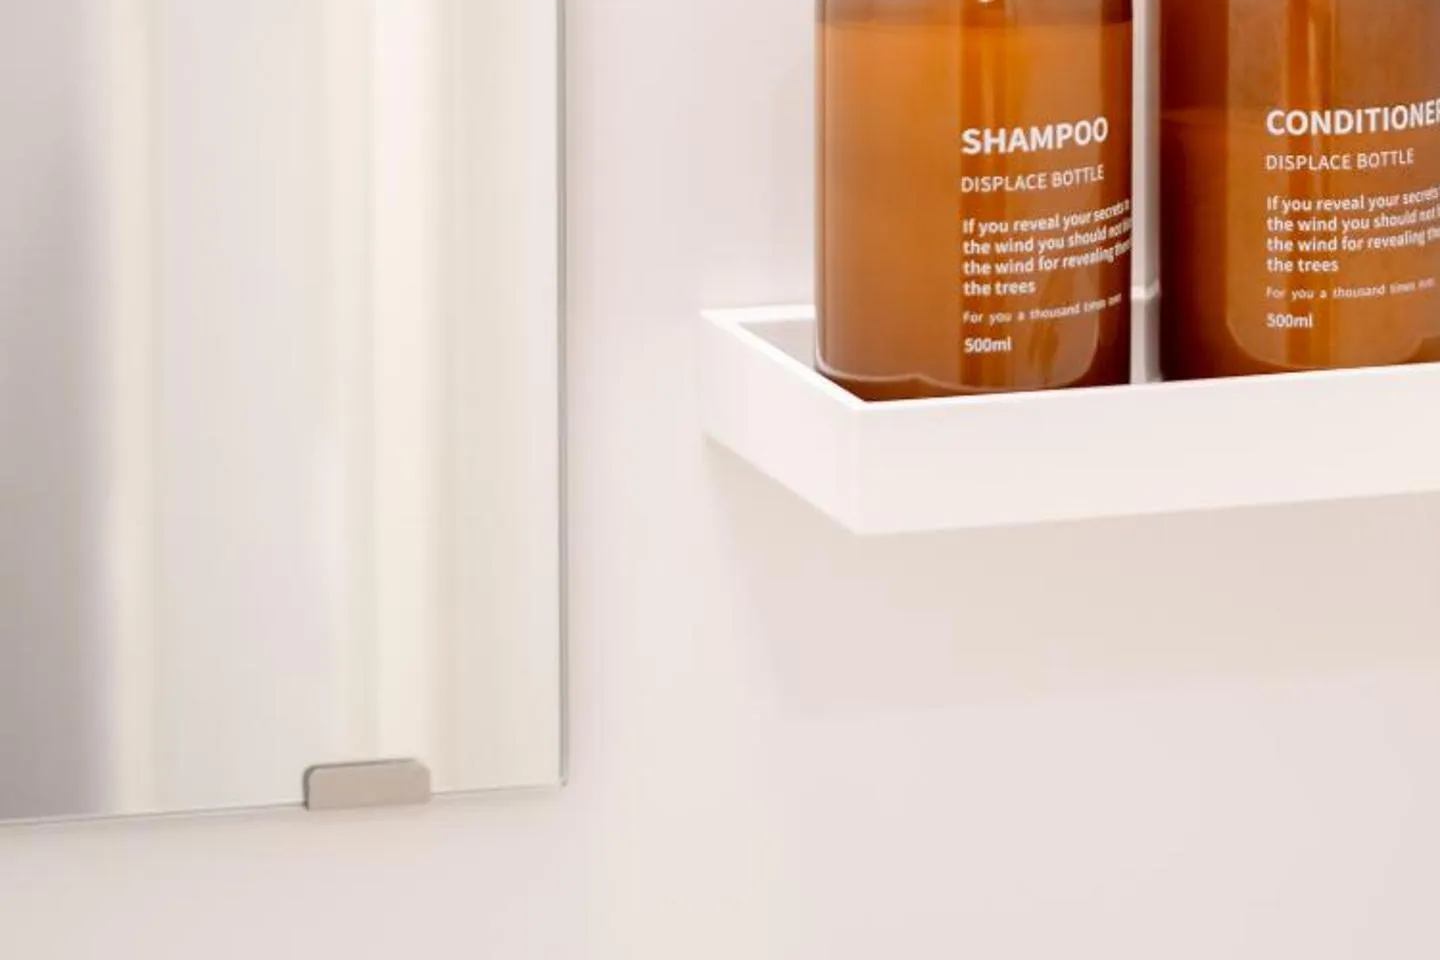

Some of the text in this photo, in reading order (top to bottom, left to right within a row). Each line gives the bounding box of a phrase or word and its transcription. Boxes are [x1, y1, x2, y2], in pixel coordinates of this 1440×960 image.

[961, 116, 1109, 155] SHAMPOO
[1265, 147, 1416, 172] DISPLACE BOTTLE
[961, 164, 1105, 193] DISPLACE BOTTLE
[1266, 195, 1280, 211] If
[1281, 199, 1312, 215] you
[1316, 194, 1365, 211] reveal
[1367, 193, 1400, 212] your
[963, 218, 975, 234] If
[978, 221, 1009, 237] you
[1013, 213, 1060, 232] reveal
[1062, 211, 1092, 232] your
[1266, 216, 1294, 232] the
[1297, 216, 1337, 232] wind
[1342, 217, 1370, 235] you
[1373, 211, 1418, 229] should
[963, 239, 991, 255] the
[995, 237, 1034, 254] wind
[1038, 236, 1065, 254] you
[1068, 224, 1107, 248] should
[1266, 236, 1294, 253] the
[1297, 236, 1337, 252] wind
[1341, 235, 1364, 250] for
[1367, 229, 1426, 249] revealing
[963, 259, 991, 276] the
[995, 257, 1034, 274] wind
[1039, 255, 1060, 271] for
[1266, 256, 1339, 273] the trees
[963, 280, 1036, 296] the trees
[1266, 285, 1286, 299] For
[1291, 288, 1315, 301] you
[1319, 289, 1328, 299] a
[1332, 282, 1385, 299] thousand
[962, 310, 984, 324] For
[989, 312, 1013, 326] you
[1029, 302, 1080, 320] thousand
[1266, 312, 1313, 329] 500ml
[963, 336, 1013, 354] 500ml
